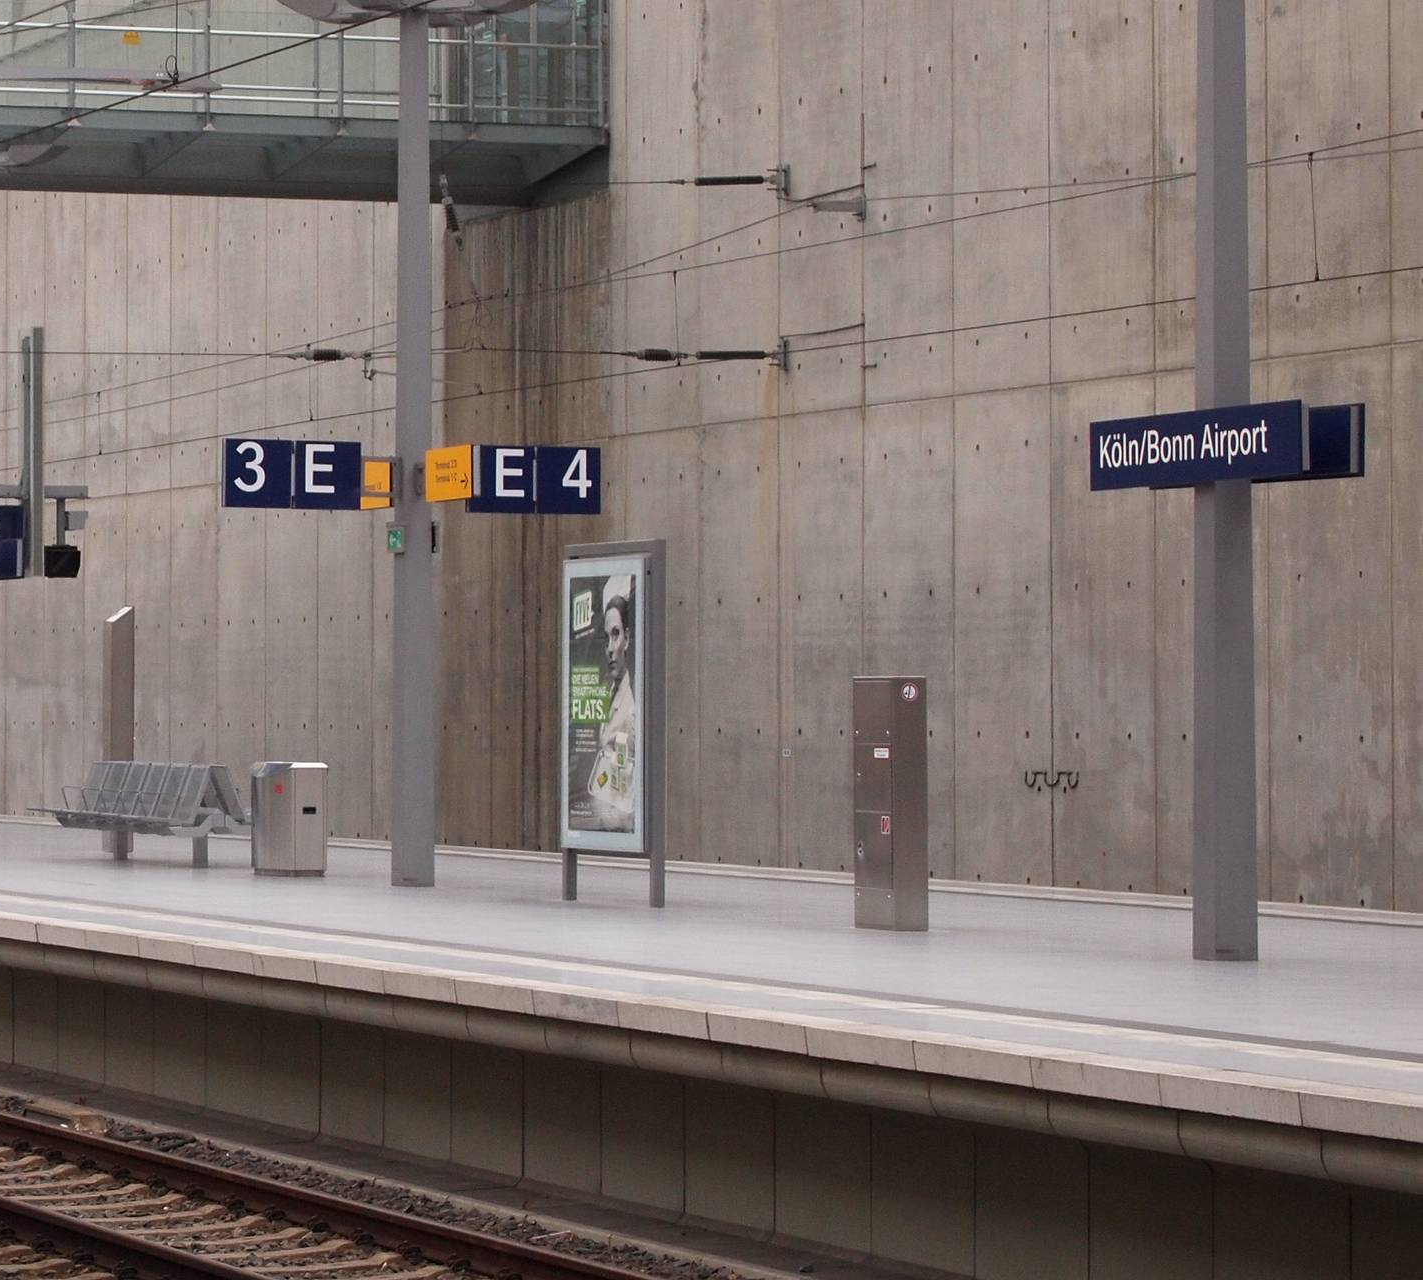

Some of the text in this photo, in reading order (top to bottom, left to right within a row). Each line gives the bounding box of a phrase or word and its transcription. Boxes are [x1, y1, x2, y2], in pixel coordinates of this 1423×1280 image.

[234, 441, 335, 494] 3 E
[1099, 419, 1268, 469] Köln/Bonn Airport
[495, 448, 592, 498] E 4
[572, 699, 606, 720] FLATS.
